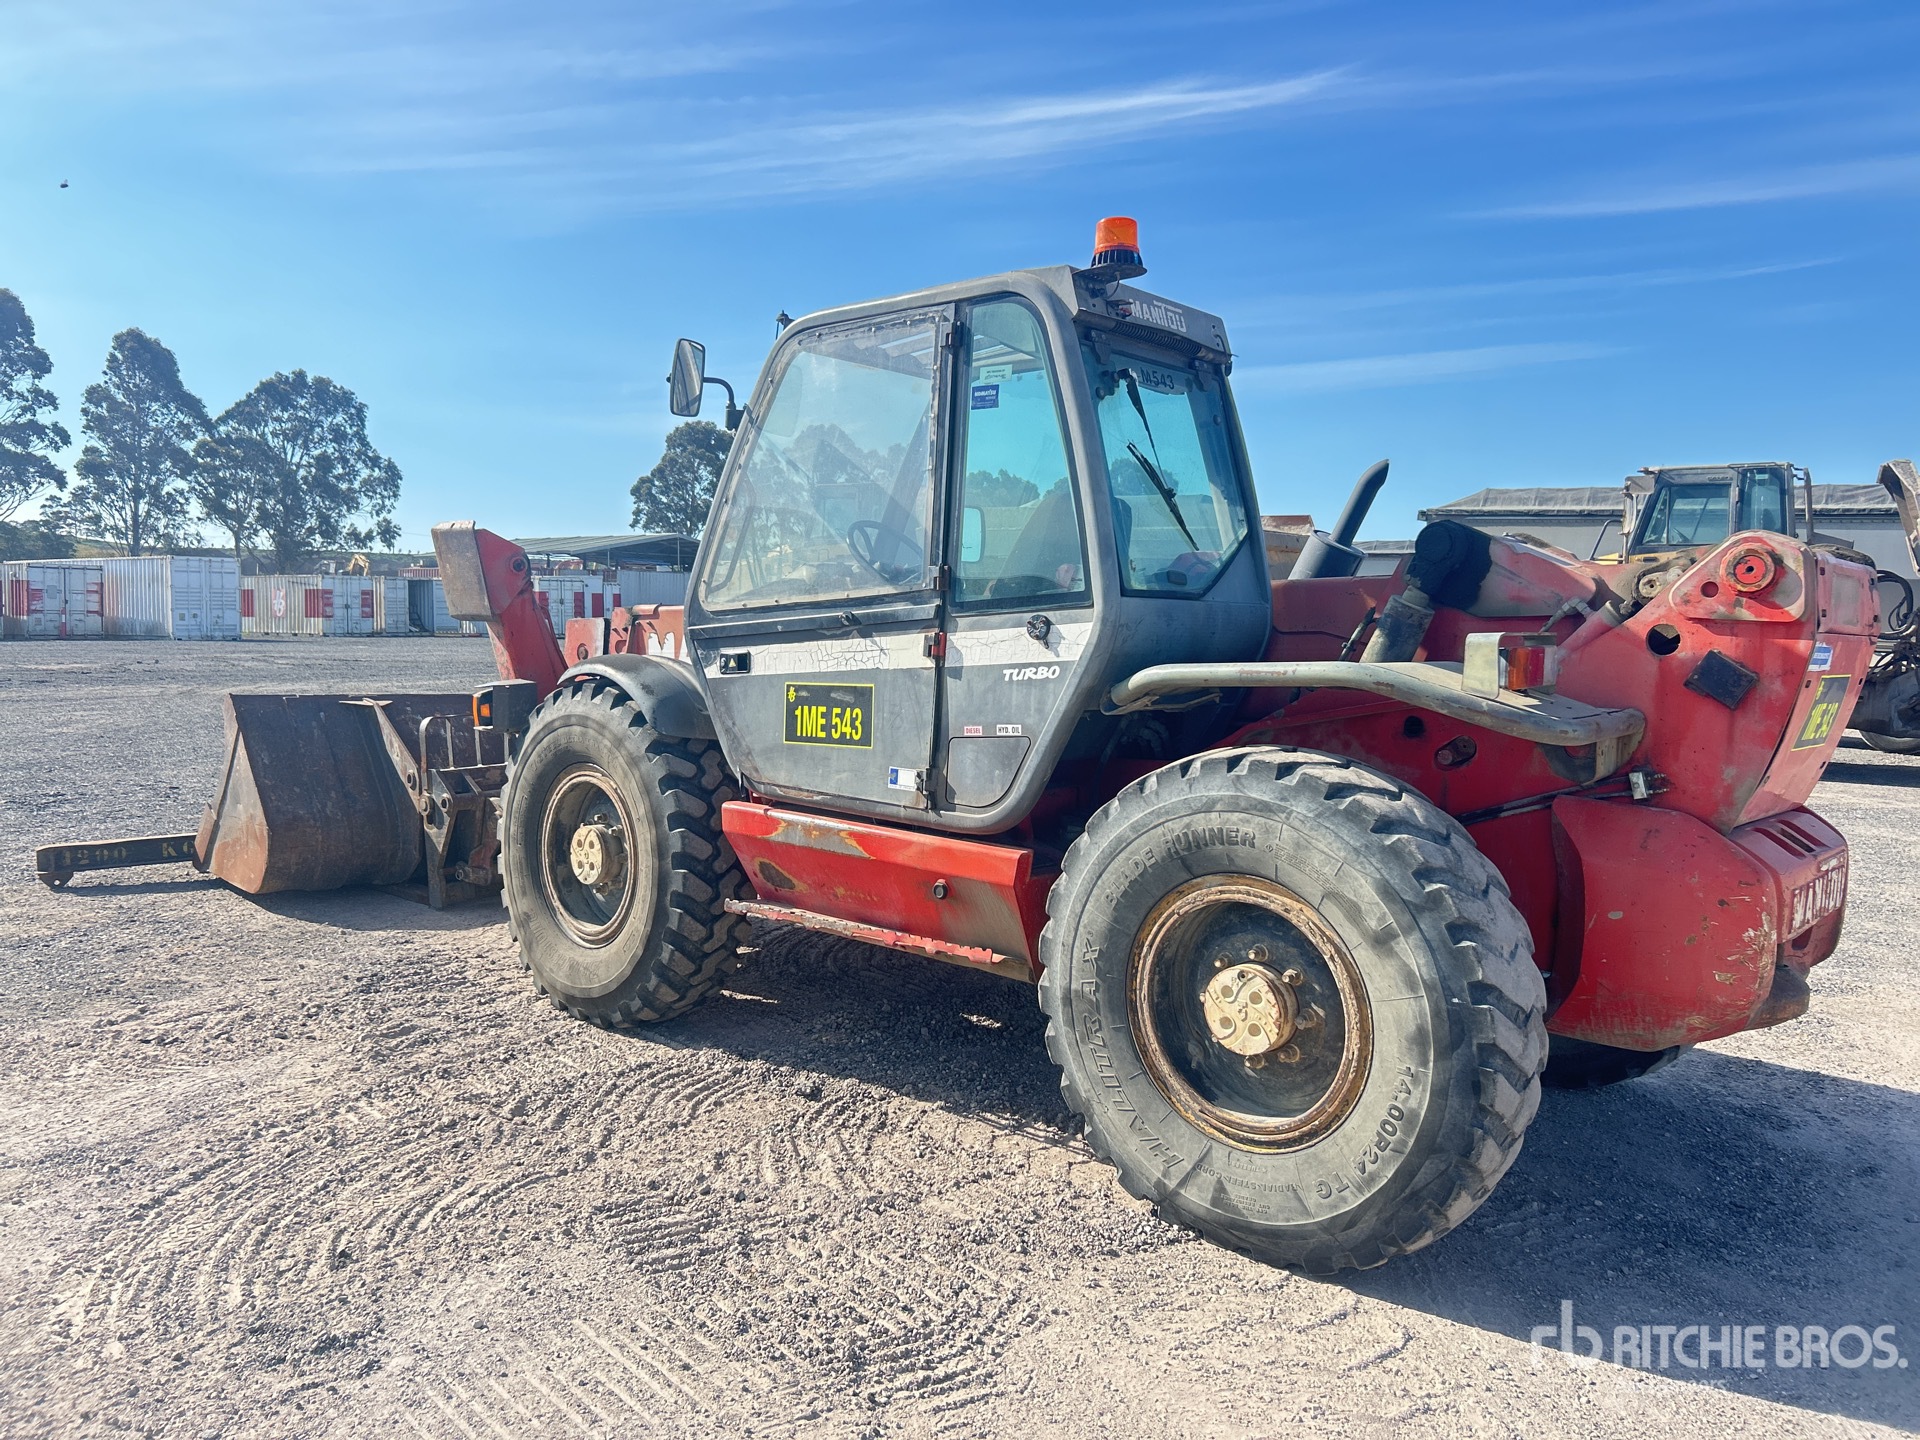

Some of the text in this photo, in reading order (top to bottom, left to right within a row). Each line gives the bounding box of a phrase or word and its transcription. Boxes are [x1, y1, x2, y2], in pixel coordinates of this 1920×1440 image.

[1129, 299, 1187, 333] MANITOU
[1003, 666, 1060, 681] TURBO
[795, 705, 862, 741] 1ME 543
[965, 727, 981, 735] DIESEL
[1012, 726, 1020, 735] OIL
[1105, 825, 1256, 905] BLADE RUNNER
[1315, 1065, 1414, 1200] 14.00R24 TG
